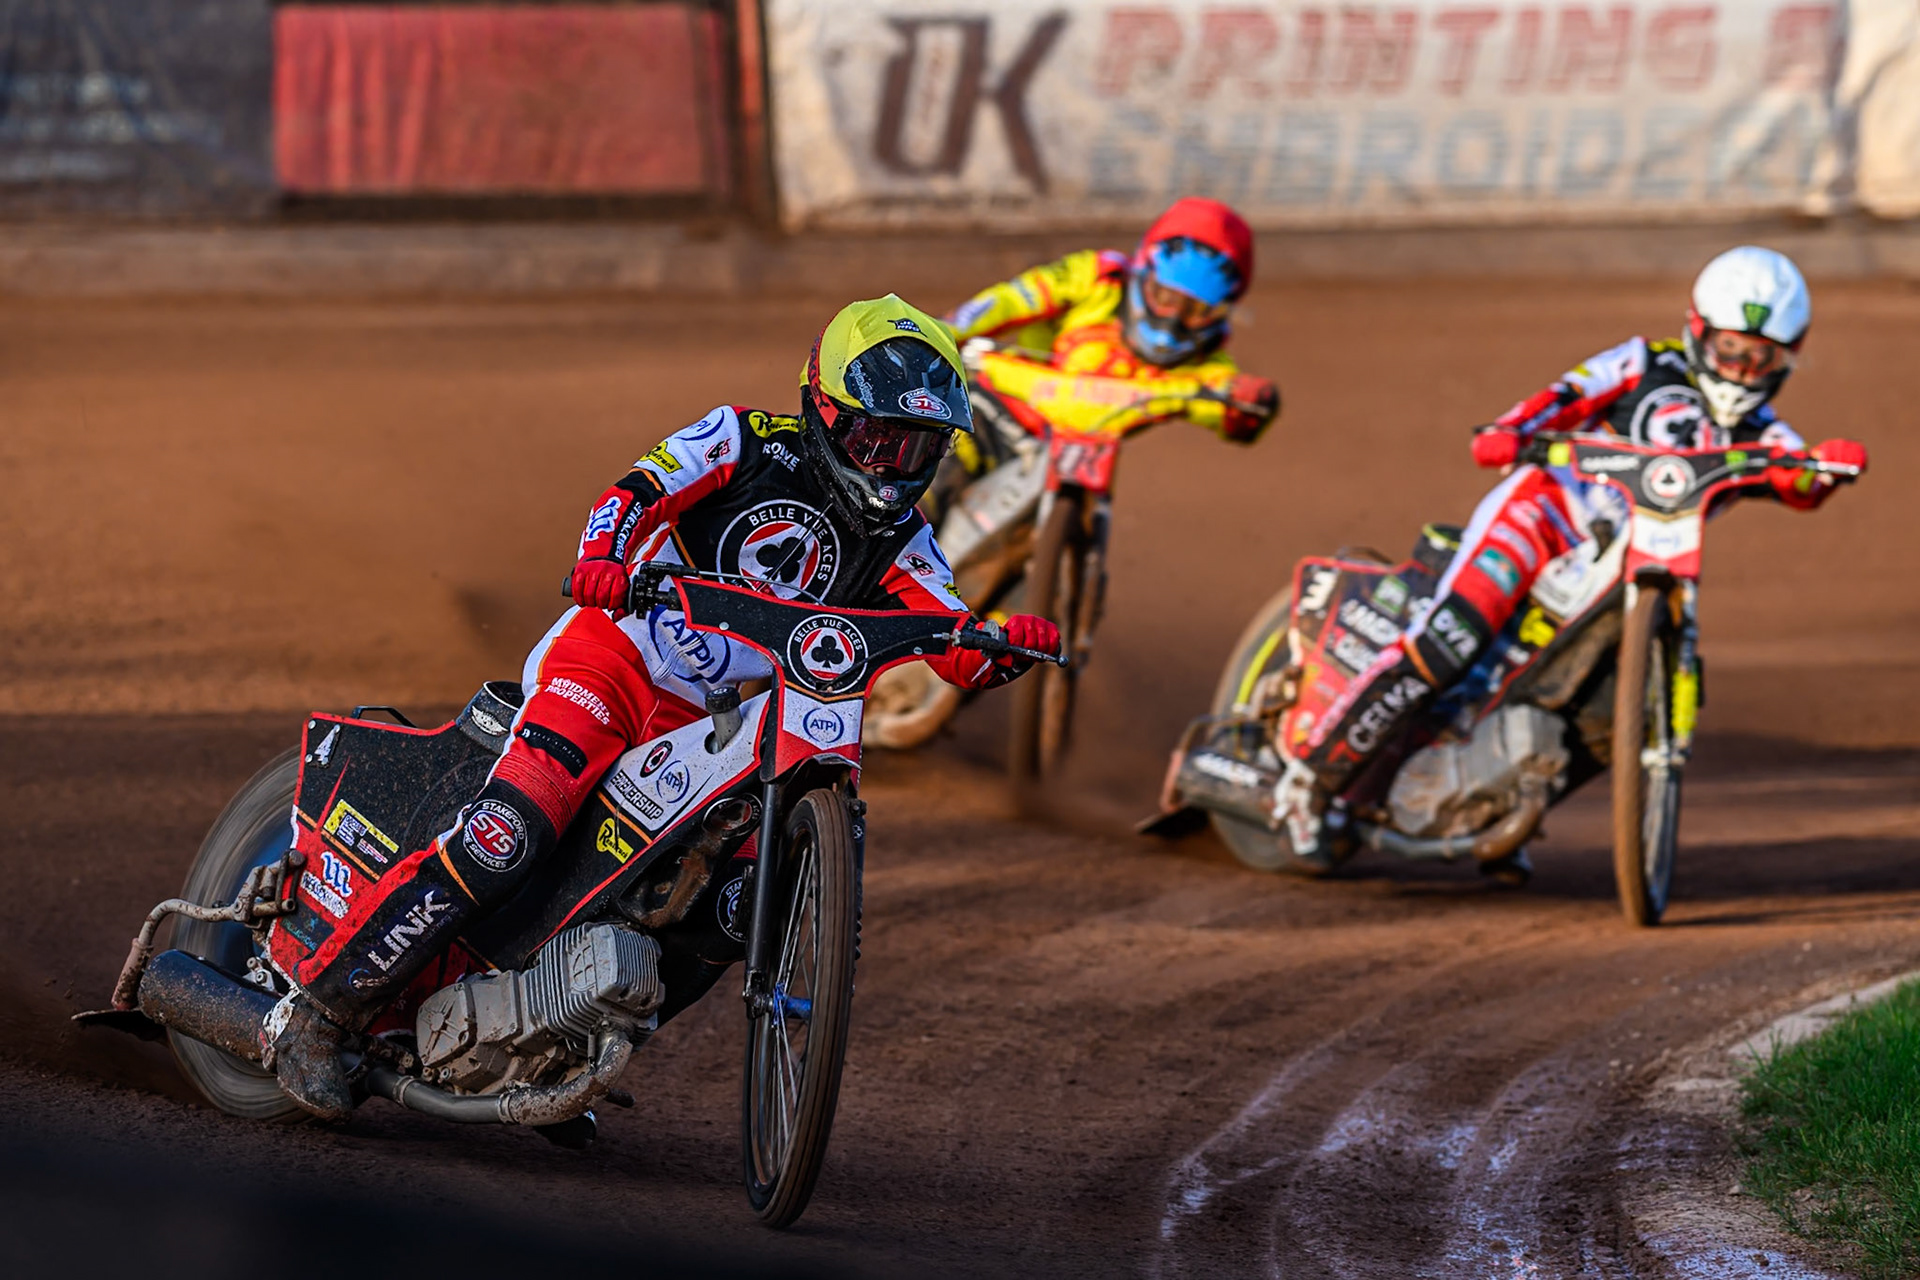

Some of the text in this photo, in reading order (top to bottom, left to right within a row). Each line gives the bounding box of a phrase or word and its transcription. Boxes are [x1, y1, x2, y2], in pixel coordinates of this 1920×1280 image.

[1095, 5, 1718, 98] PRINTING
[909, 397, 941, 411] STS
[762, 442, 800, 468] ROWE
[880, 489, 900, 498] STS
[748, 507, 834, 581] BELLE VUE ACES
[662, 618, 716, 671] ATPI
[793, 618, 863, 651] BELLE VUE ACES
[544, 684, 611, 726] PROPERTIES
[809, 717, 837, 732] ATPI
[662, 770, 685, 793] ATPI
[471, 813, 516, 853] STS
[481, 802, 525, 840] STAKEFORD
[469, 843, 507, 868] SERVICES
[367, 890, 452, 972] LINK
